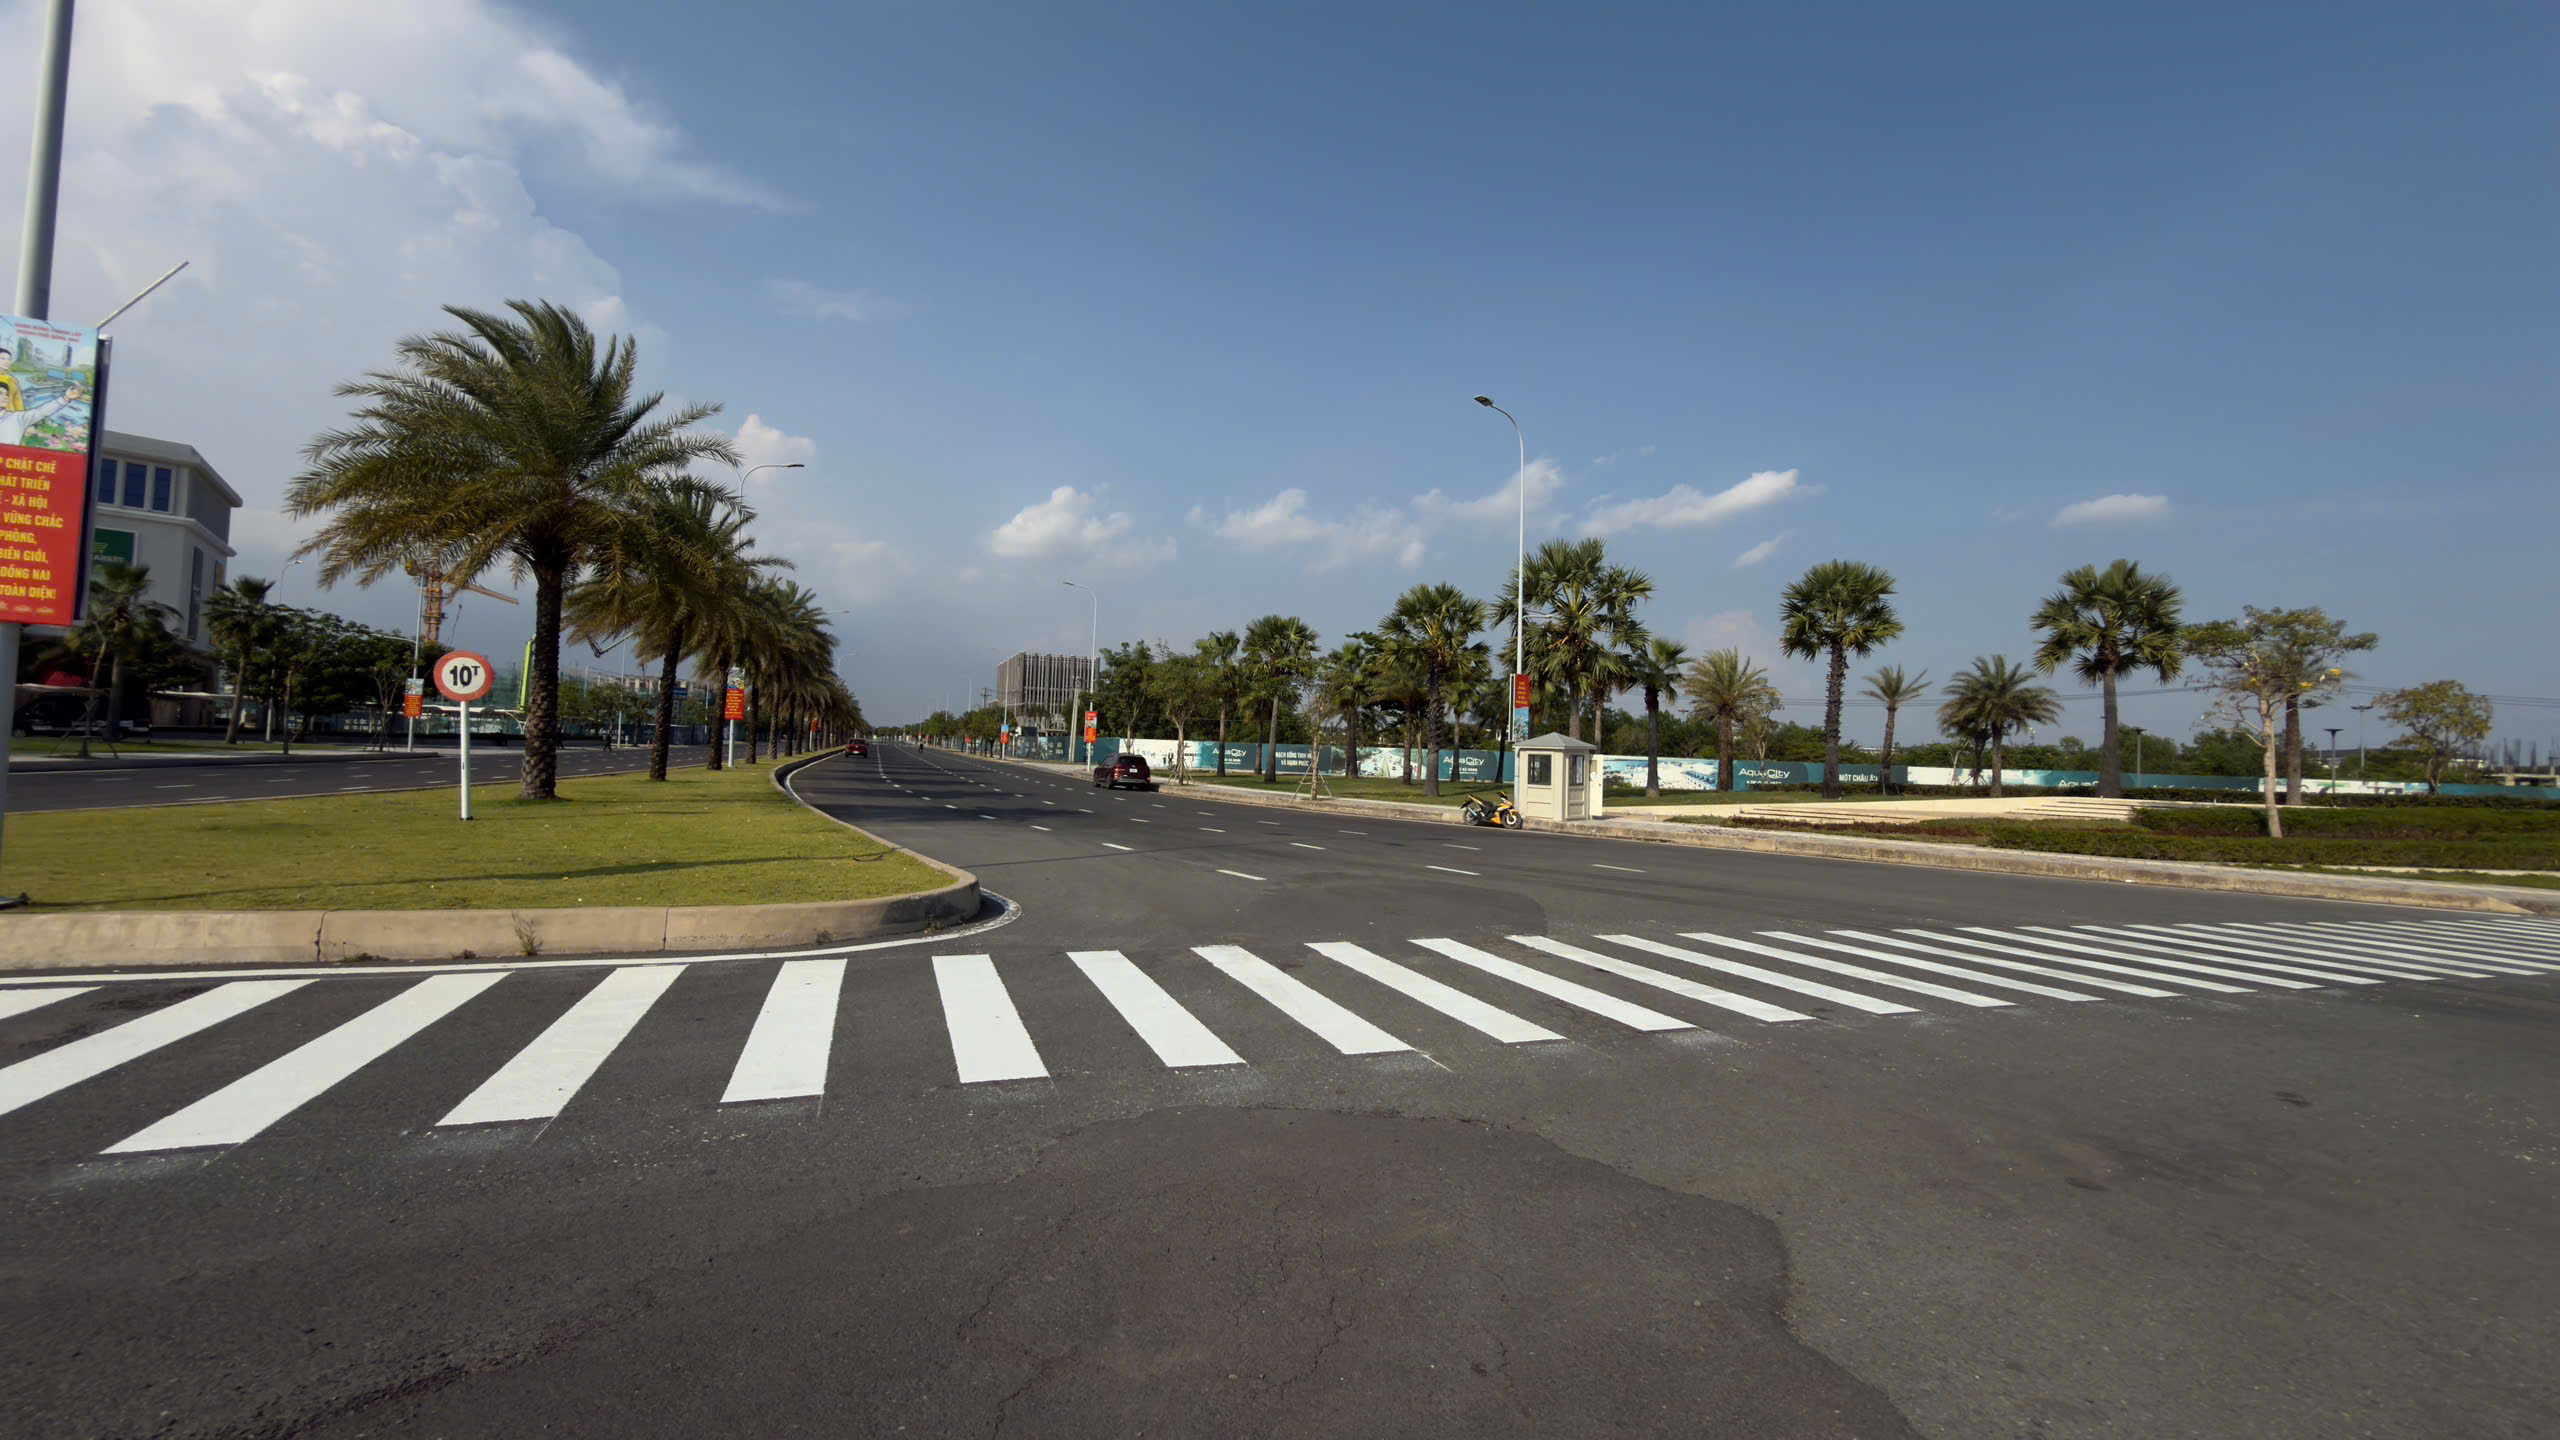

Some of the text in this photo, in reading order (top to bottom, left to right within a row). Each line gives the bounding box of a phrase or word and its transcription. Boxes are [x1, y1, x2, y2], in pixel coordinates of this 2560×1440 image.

[33, 568, 51, 581] NAI
[1838, 773, 1852, 783] MỘT
[1853, 773, 1869, 783] CHÂU
